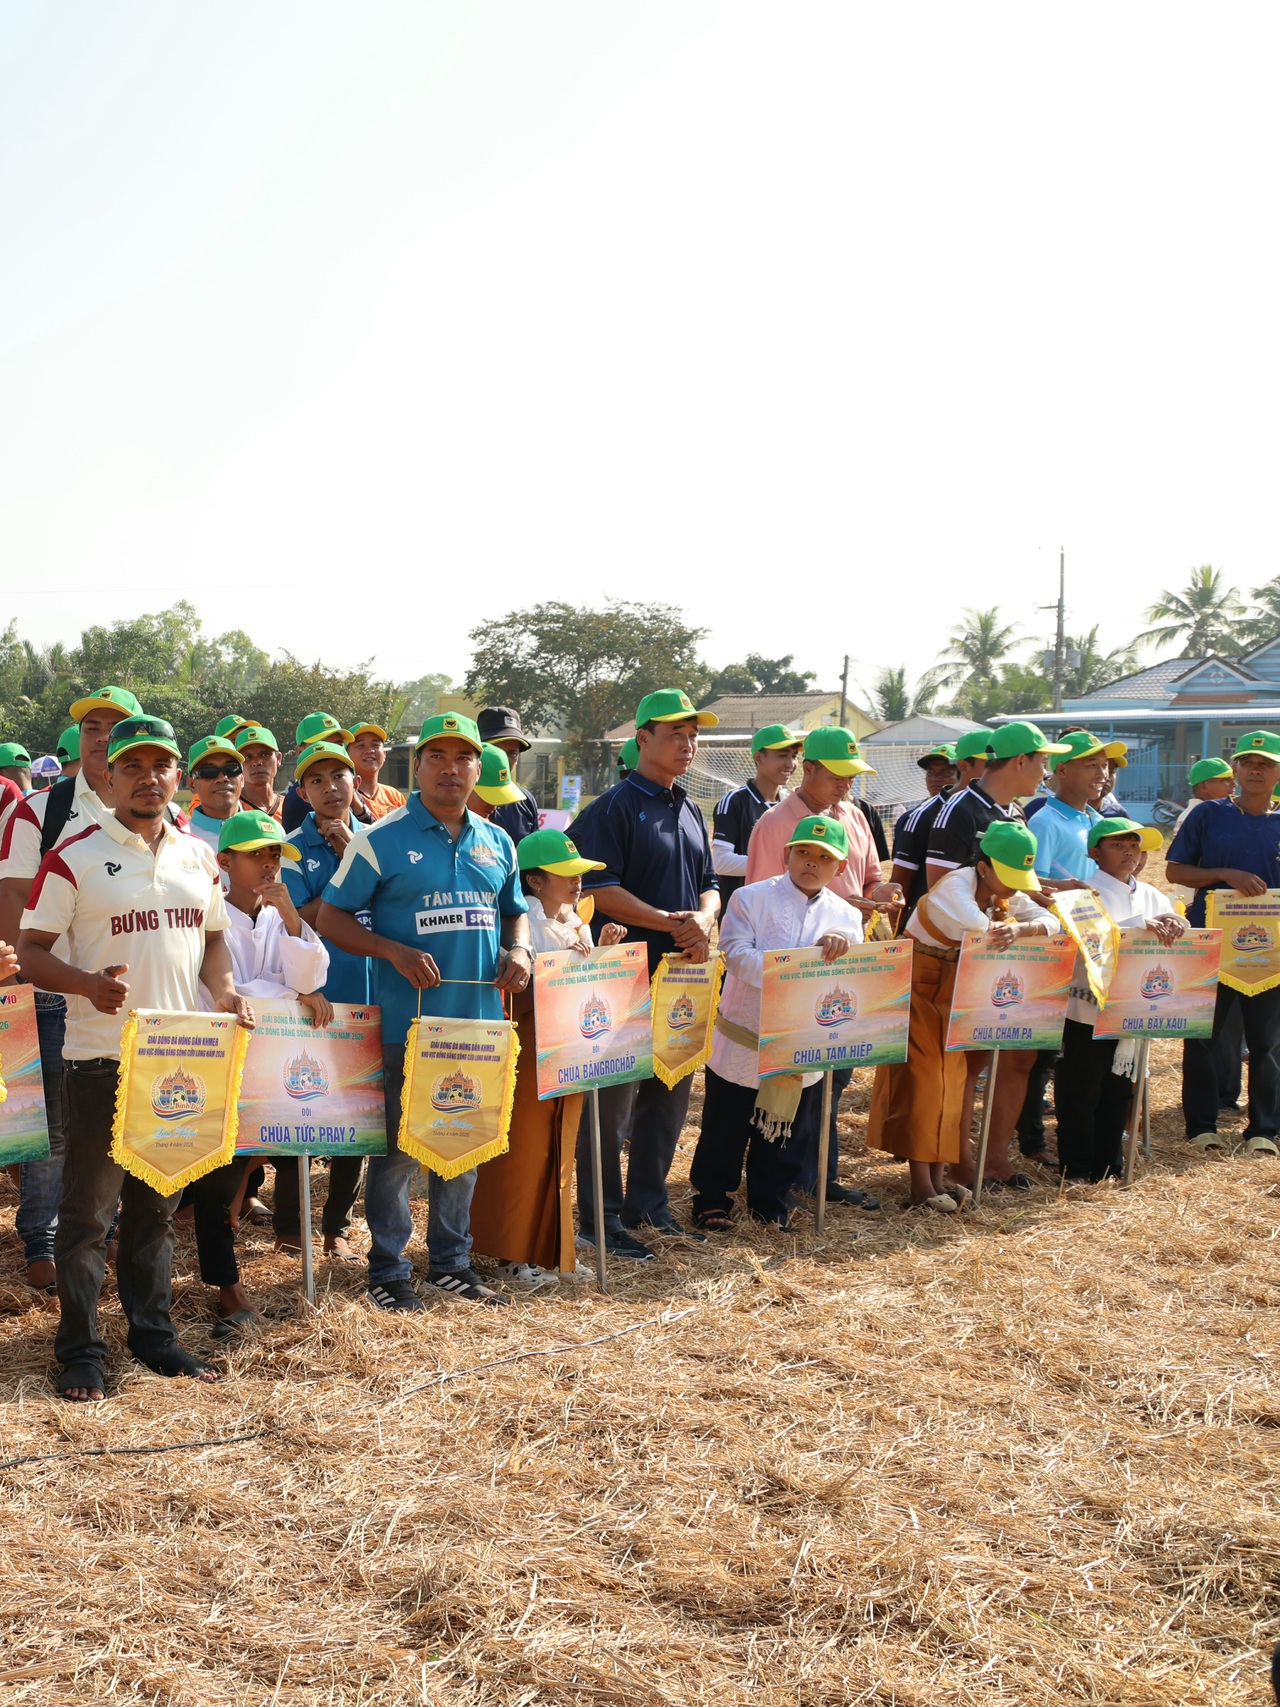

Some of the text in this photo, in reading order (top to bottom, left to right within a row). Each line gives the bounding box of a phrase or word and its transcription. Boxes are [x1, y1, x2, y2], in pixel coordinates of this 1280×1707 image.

[423, 891, 453, 907] TÂN
[111, 909, 159, 936] BƯNG
[420, 914, 494, 927] KHMER SPOR
[996, 1028, 1020, 1039] CHAM
[1022, 1028, 1032, 1039] PA
[826, 1046, 846, 1060] TAM
[261, 1123, 356, 1143] CHÙA TỨC PRAY 2
